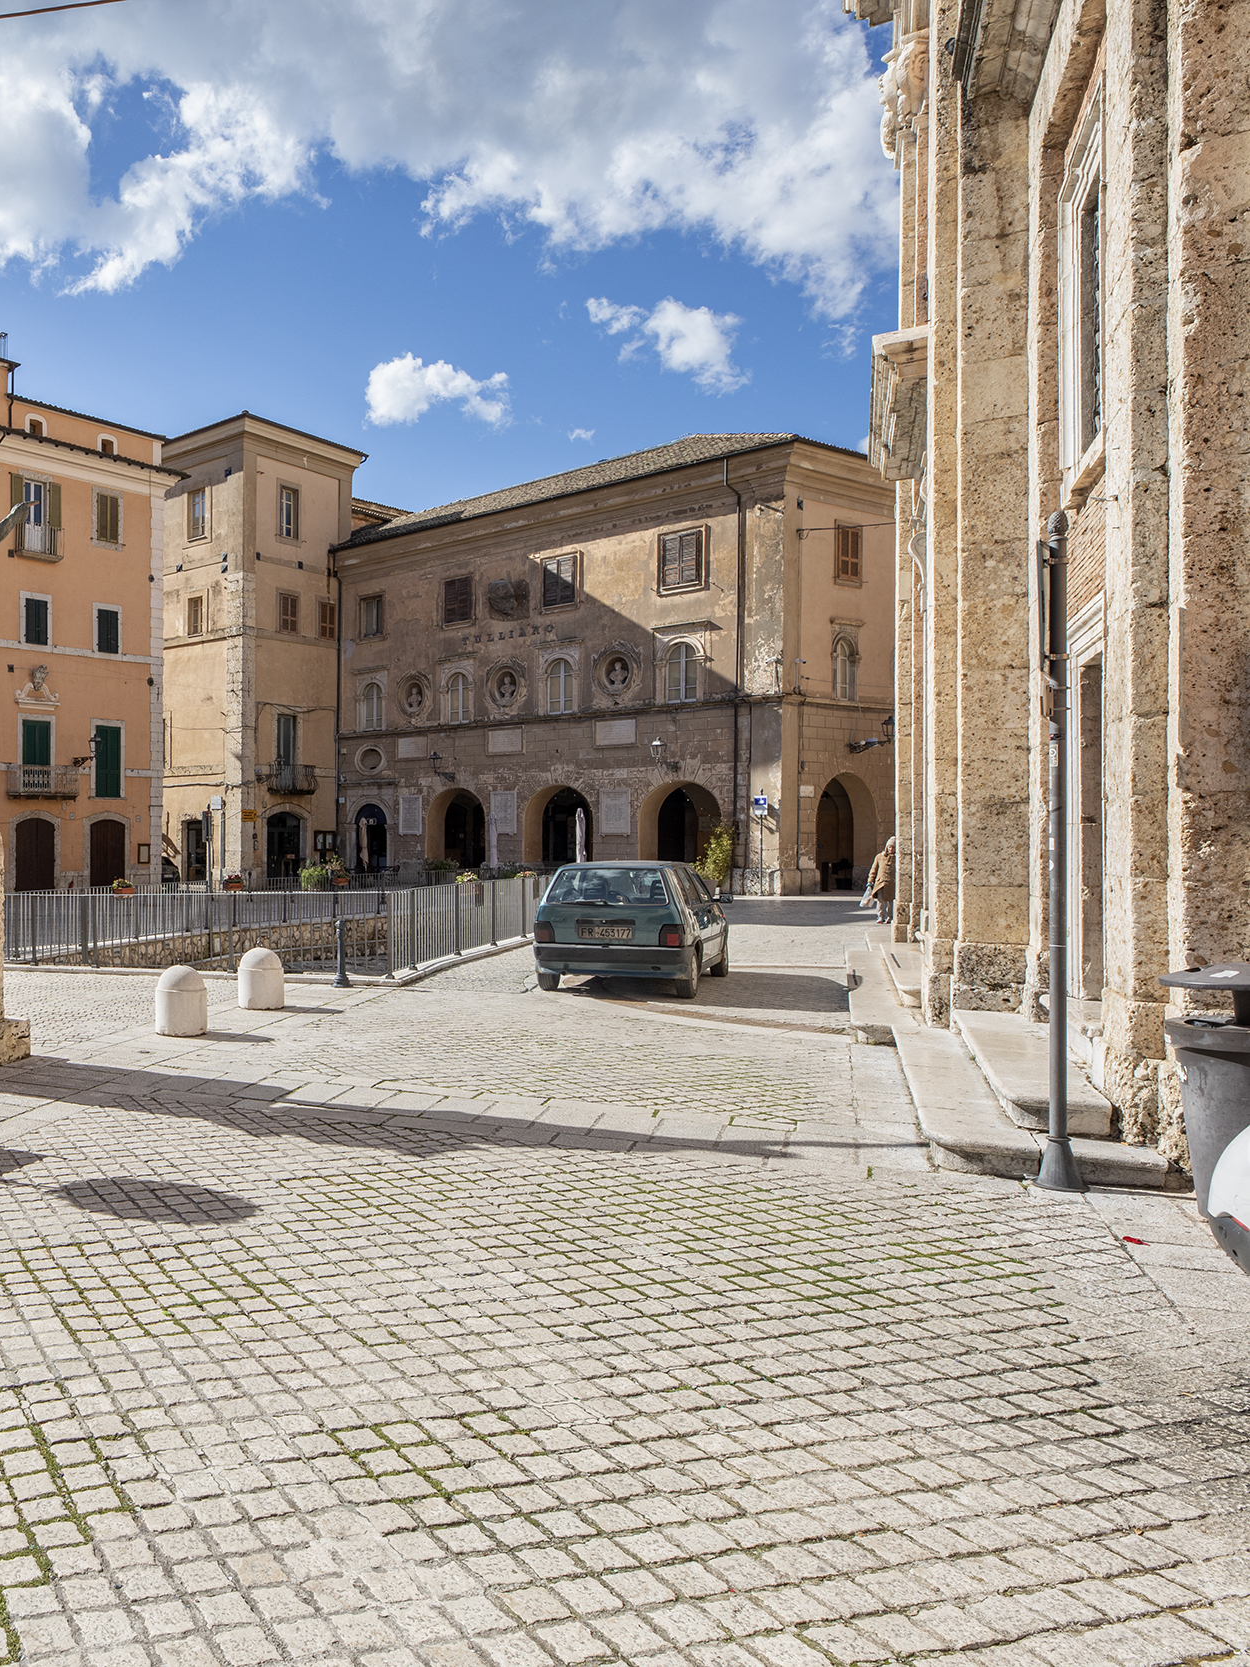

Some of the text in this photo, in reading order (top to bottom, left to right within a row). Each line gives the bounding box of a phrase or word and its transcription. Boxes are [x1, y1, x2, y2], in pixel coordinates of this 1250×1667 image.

[461, 623, 555, 646] TULLIANO
[580, 927, 632, 938] FR 453177
